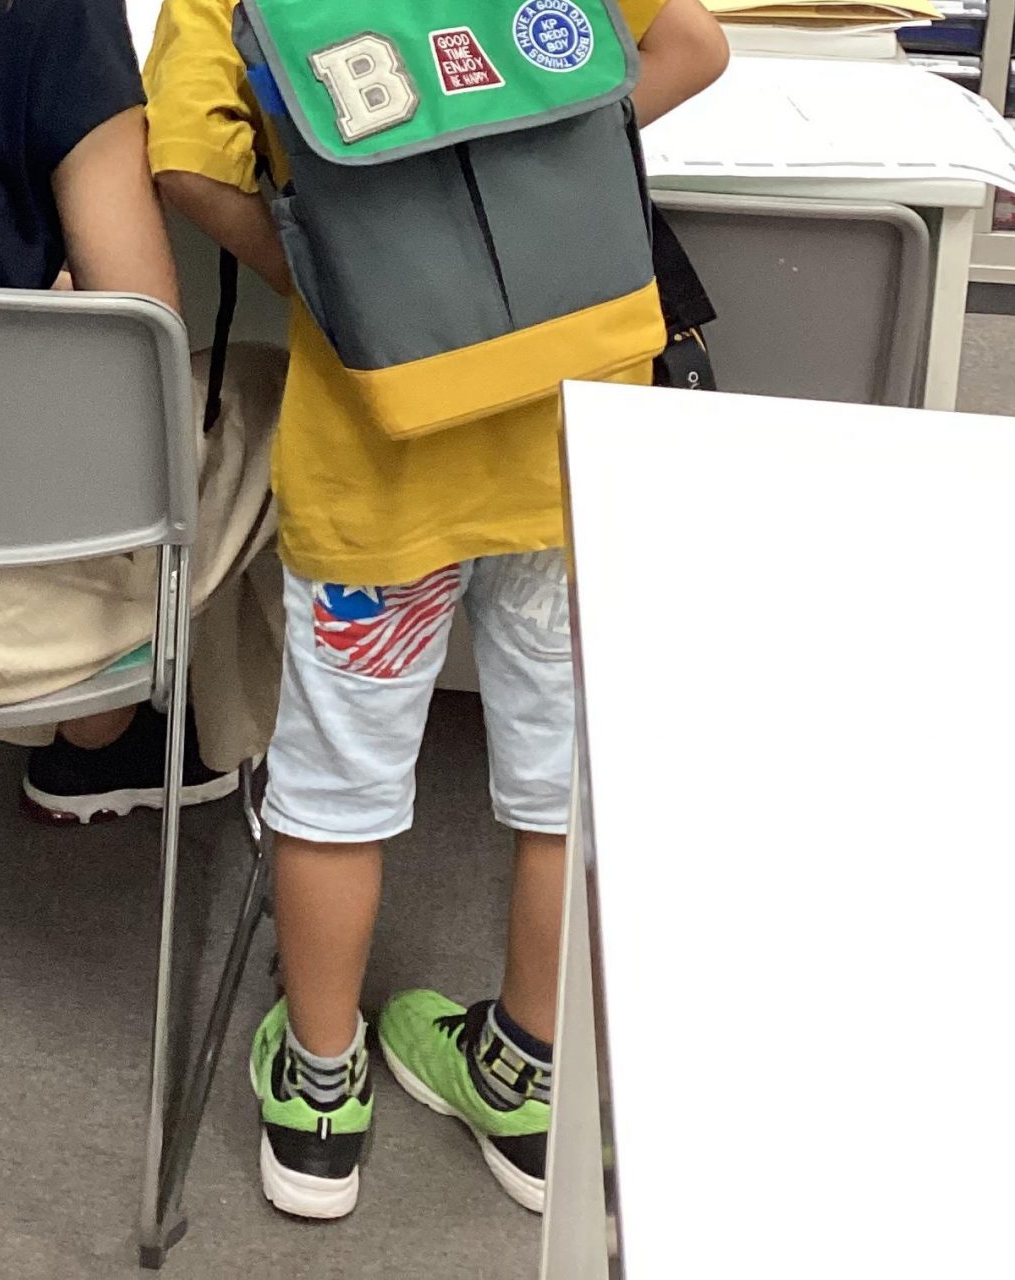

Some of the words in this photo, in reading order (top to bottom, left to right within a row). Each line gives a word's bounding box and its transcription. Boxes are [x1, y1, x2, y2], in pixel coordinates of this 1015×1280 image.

[525, 6, 537, 18] A
[540, 18, 558, 31] KP
[569, 9, 590, 33] DAY
[517, 15, 532, 48] HAVE
[538, 27, 569, 43] DECO
[438, 33, 470, 49] GOOD
[546, 37, 569, 53] BOY
[571, 36, 590, 63] BEST
[443, 46, 473, 60] TIME
[528, 48, 573, 69] THINGS
[442, 56, 484, 75] ENJOY
[310, 33, 419, 141] B
[449, 75, 464, 88] BE
[463, 71, 490, 85] HAPPY
